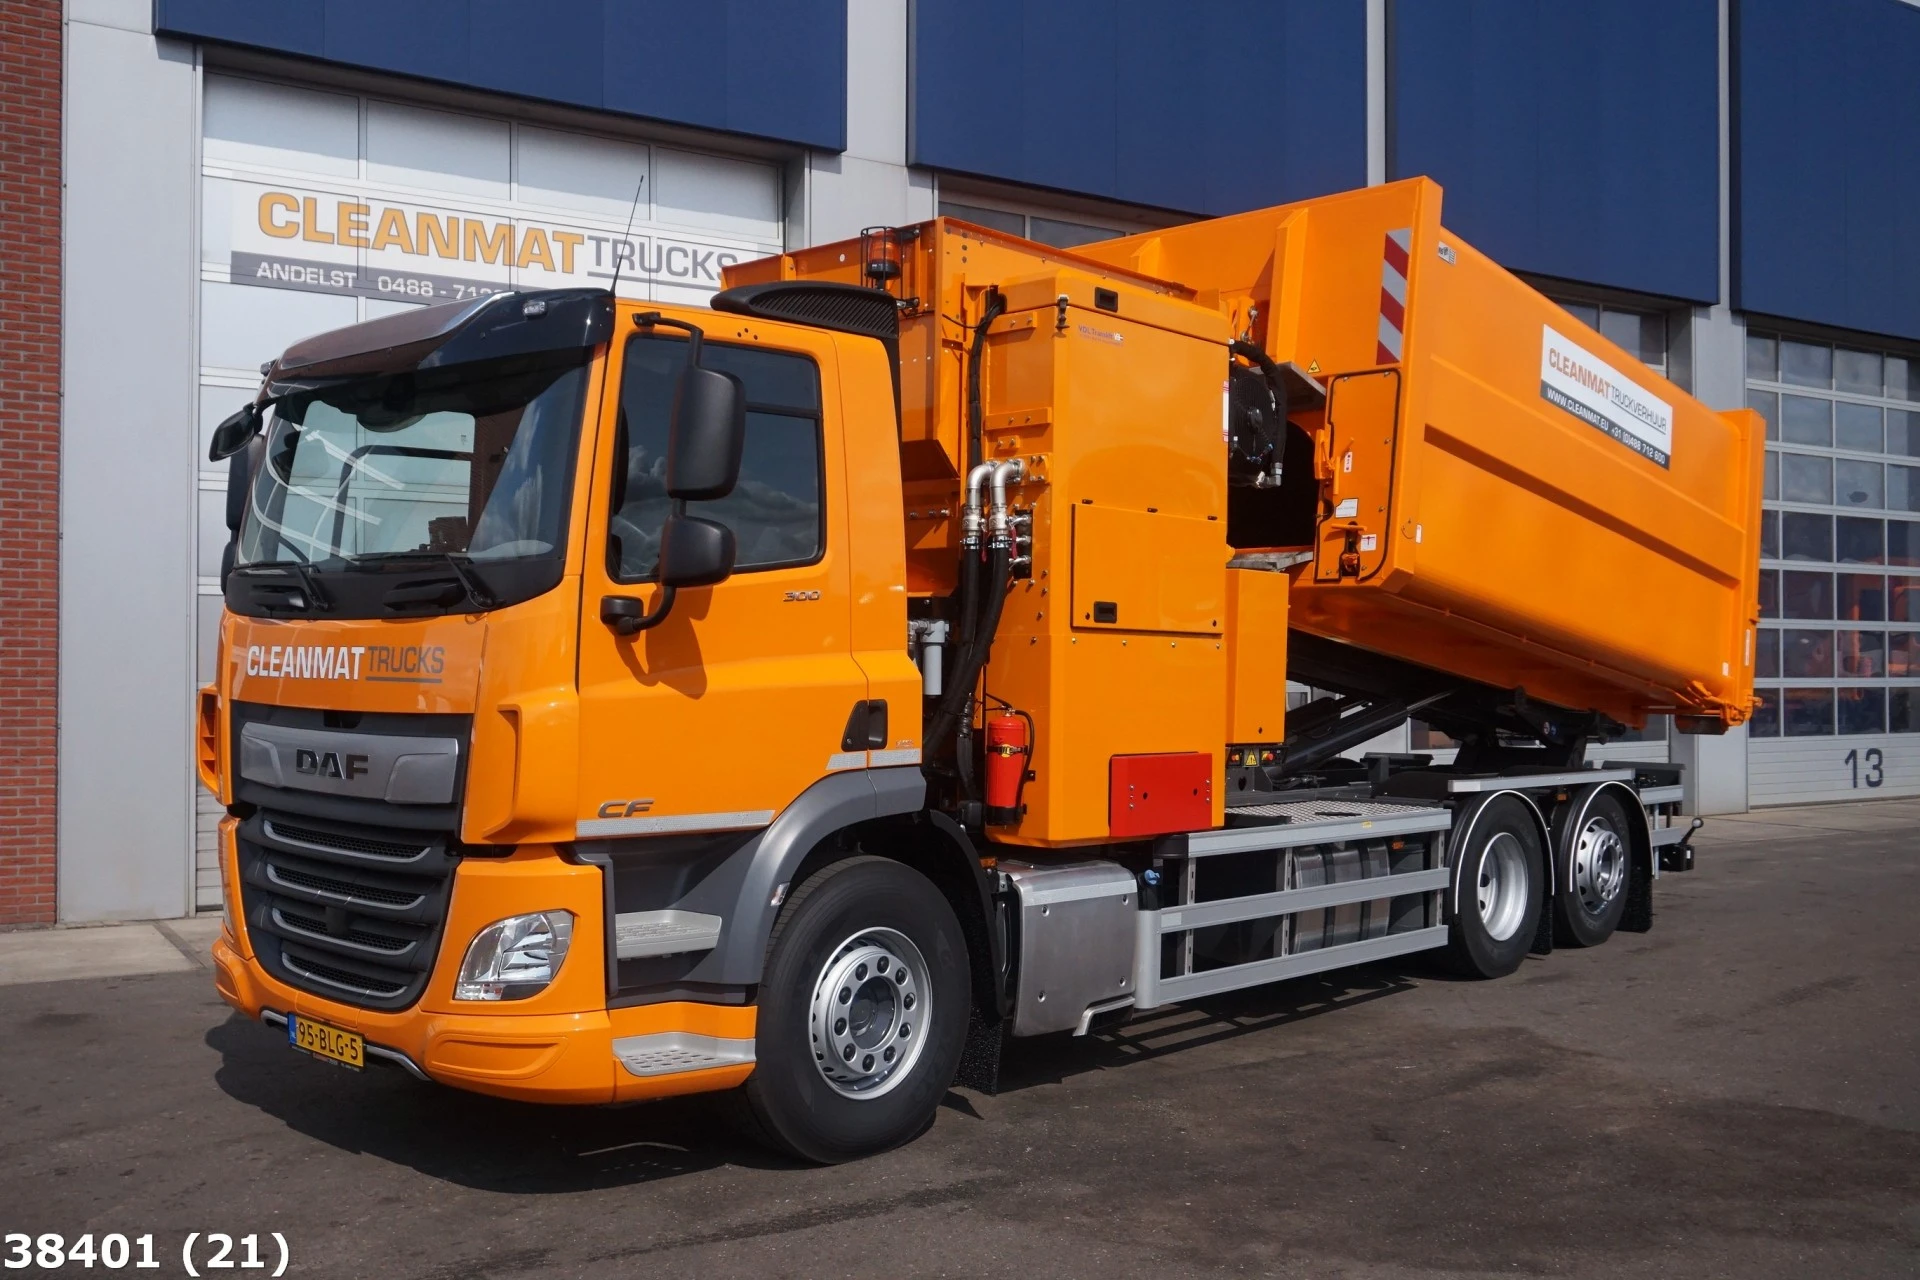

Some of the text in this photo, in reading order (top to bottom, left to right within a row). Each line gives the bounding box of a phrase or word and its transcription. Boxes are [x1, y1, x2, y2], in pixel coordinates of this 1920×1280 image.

[258, 191, 585, 275] CLEANMAT
[256, 261, 357, 289] ANDELST
[378, 275, 433, 297] 0488
[1548, 347, 1667, 431] CLEANMAT TRUCKVERHUUR
[1547, 387, 1609, 431] WWW.CLEANMAT.EU
[1611, 426, 1622, 439] +31
[1642, 443, 1653, 457] 712
[783, 590, 820, 602] 300
[247, 645, 445, 680] CLEANMAT TRUCKS
[296, 748, 369, 780] DAF
[1844, 747, 1884, 789] 13
[598, 798, 655, 818] CF
[299, 1021, 359, 1060] 95-BLG-5
